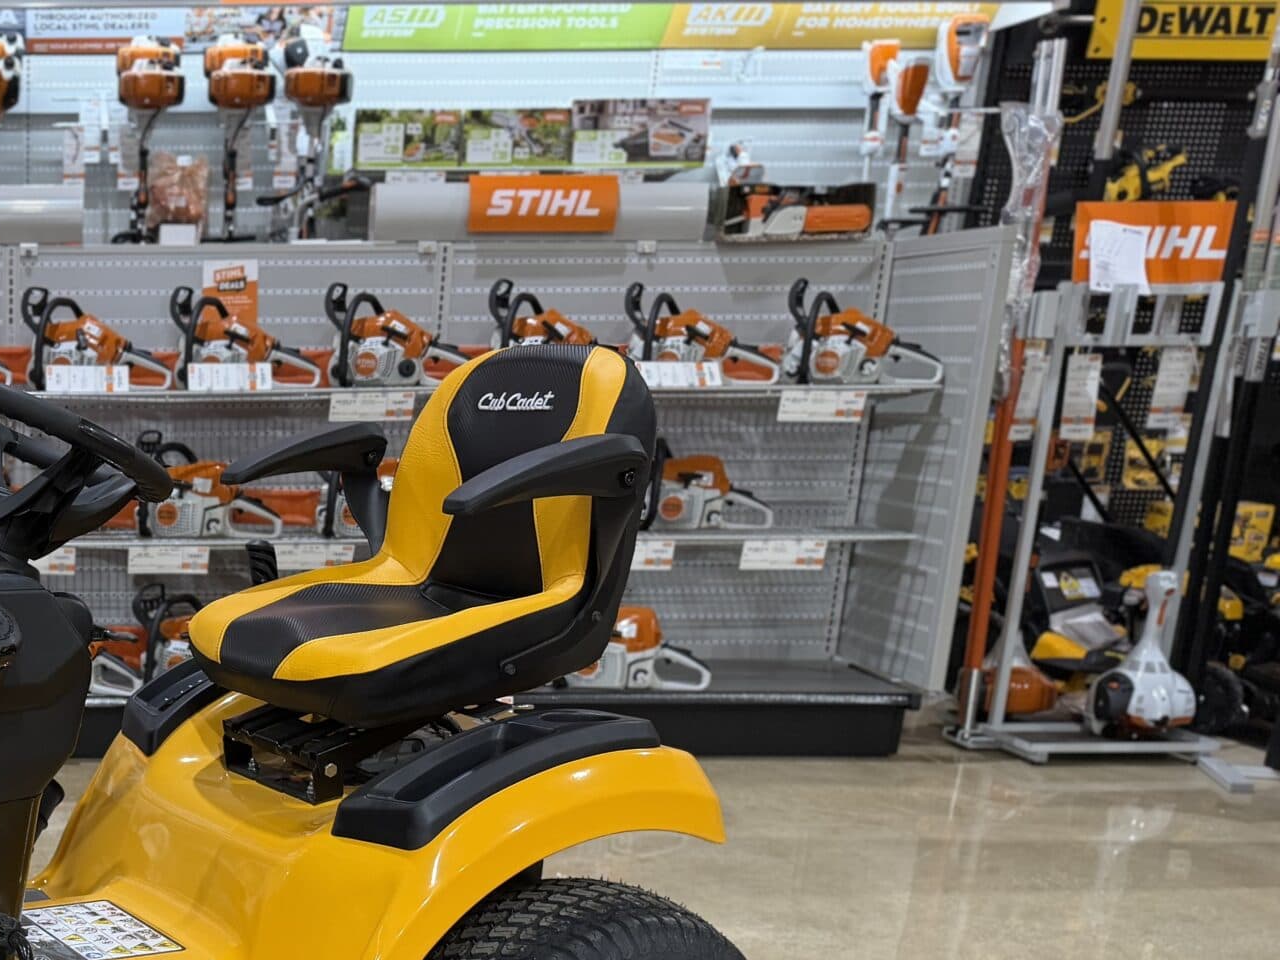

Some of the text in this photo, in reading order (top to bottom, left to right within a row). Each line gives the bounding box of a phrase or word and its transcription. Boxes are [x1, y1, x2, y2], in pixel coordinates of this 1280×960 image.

[34, 12, 158, 21] THROUGH AUTHORIZED
[473, 16, 618, 29] PRECISION TOOLS
[795, 16, 830, 28] FOR
[33, 22, 150, 31] LOCAL STIHL DEALERS
[486, 189, 600, 217] STIHL
[1078, 225, 1228, 260] IHL
[478, 391, 555, 410] Cub Cadet
